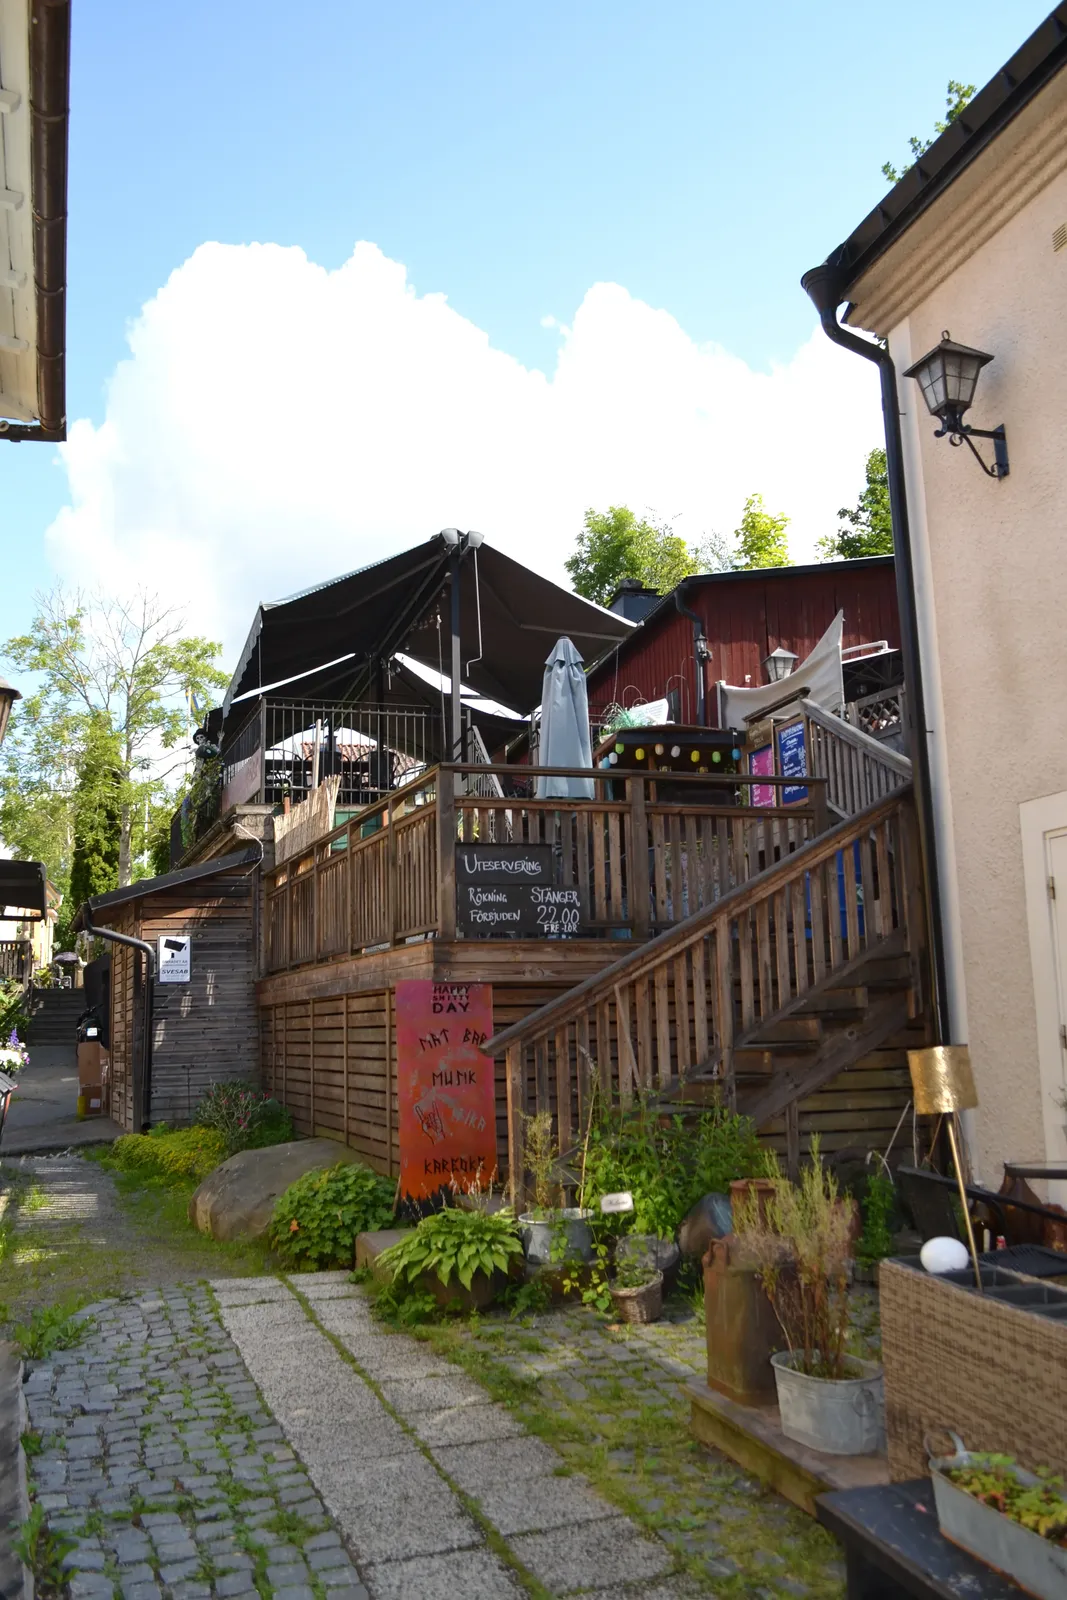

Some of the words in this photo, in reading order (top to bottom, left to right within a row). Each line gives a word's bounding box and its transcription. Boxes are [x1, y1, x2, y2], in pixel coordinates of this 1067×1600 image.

[464, 853, 542, 875] UTESERVERING
[467, 887, 508, 906] RÖKNING
[530, 887, 580, 907] STÄNGER
[469, 909, 520, 925] FÖRBJUDEN
[432, 985, 470, 994] HAPPY
[432, 1002, 470, 1014] DAY
[418, 1028, 449, 1052] MAT
